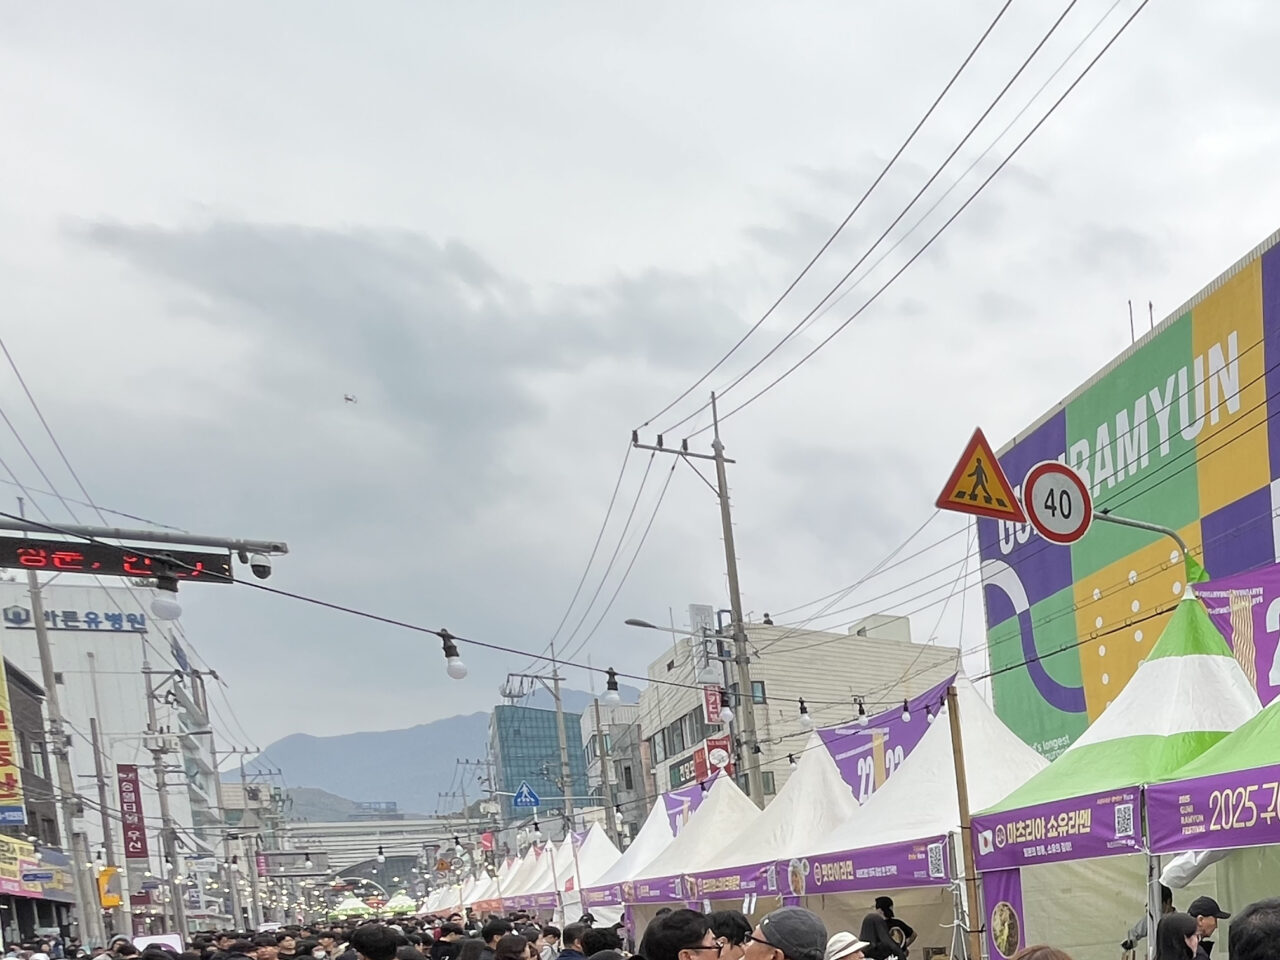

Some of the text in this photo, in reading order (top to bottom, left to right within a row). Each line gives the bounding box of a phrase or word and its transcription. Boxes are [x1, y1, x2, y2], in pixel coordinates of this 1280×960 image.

[1069, 330, 1241, 498] RAMYUN
[1043, 487, 1072, 520] 40
[44, 610, 147, 632] 바른유병원
[1006, 816, 1046, 844] 마츠리야
[1047, 808, 1092, 838] 쇼유라멘
[1209, 785, 1259, 831] 2025
